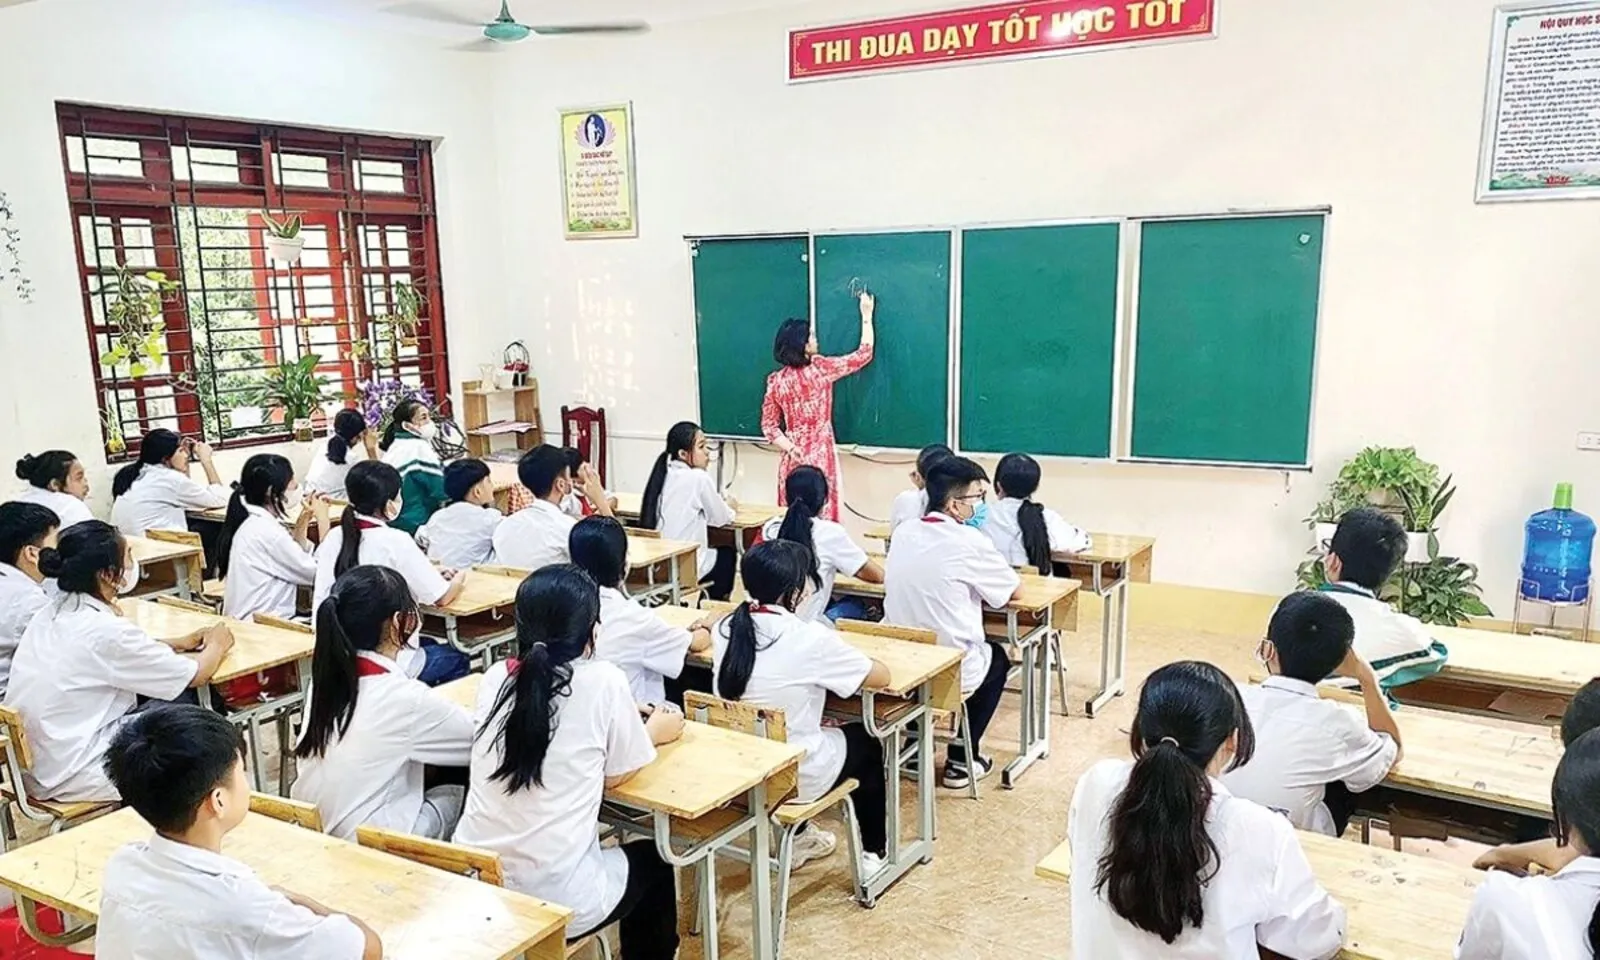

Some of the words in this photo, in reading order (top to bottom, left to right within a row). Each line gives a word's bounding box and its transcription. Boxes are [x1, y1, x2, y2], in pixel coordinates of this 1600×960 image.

[811, 39, 852, 65] THI
[859, 31, 915, 60] ĐUA
[923, 22, 979, 55] DẠY
[988, 8, 1042, 45] TỐT
[1050, 6, 1116, 41] HỌC
[1540, 18, 1555, 30] NỘI
